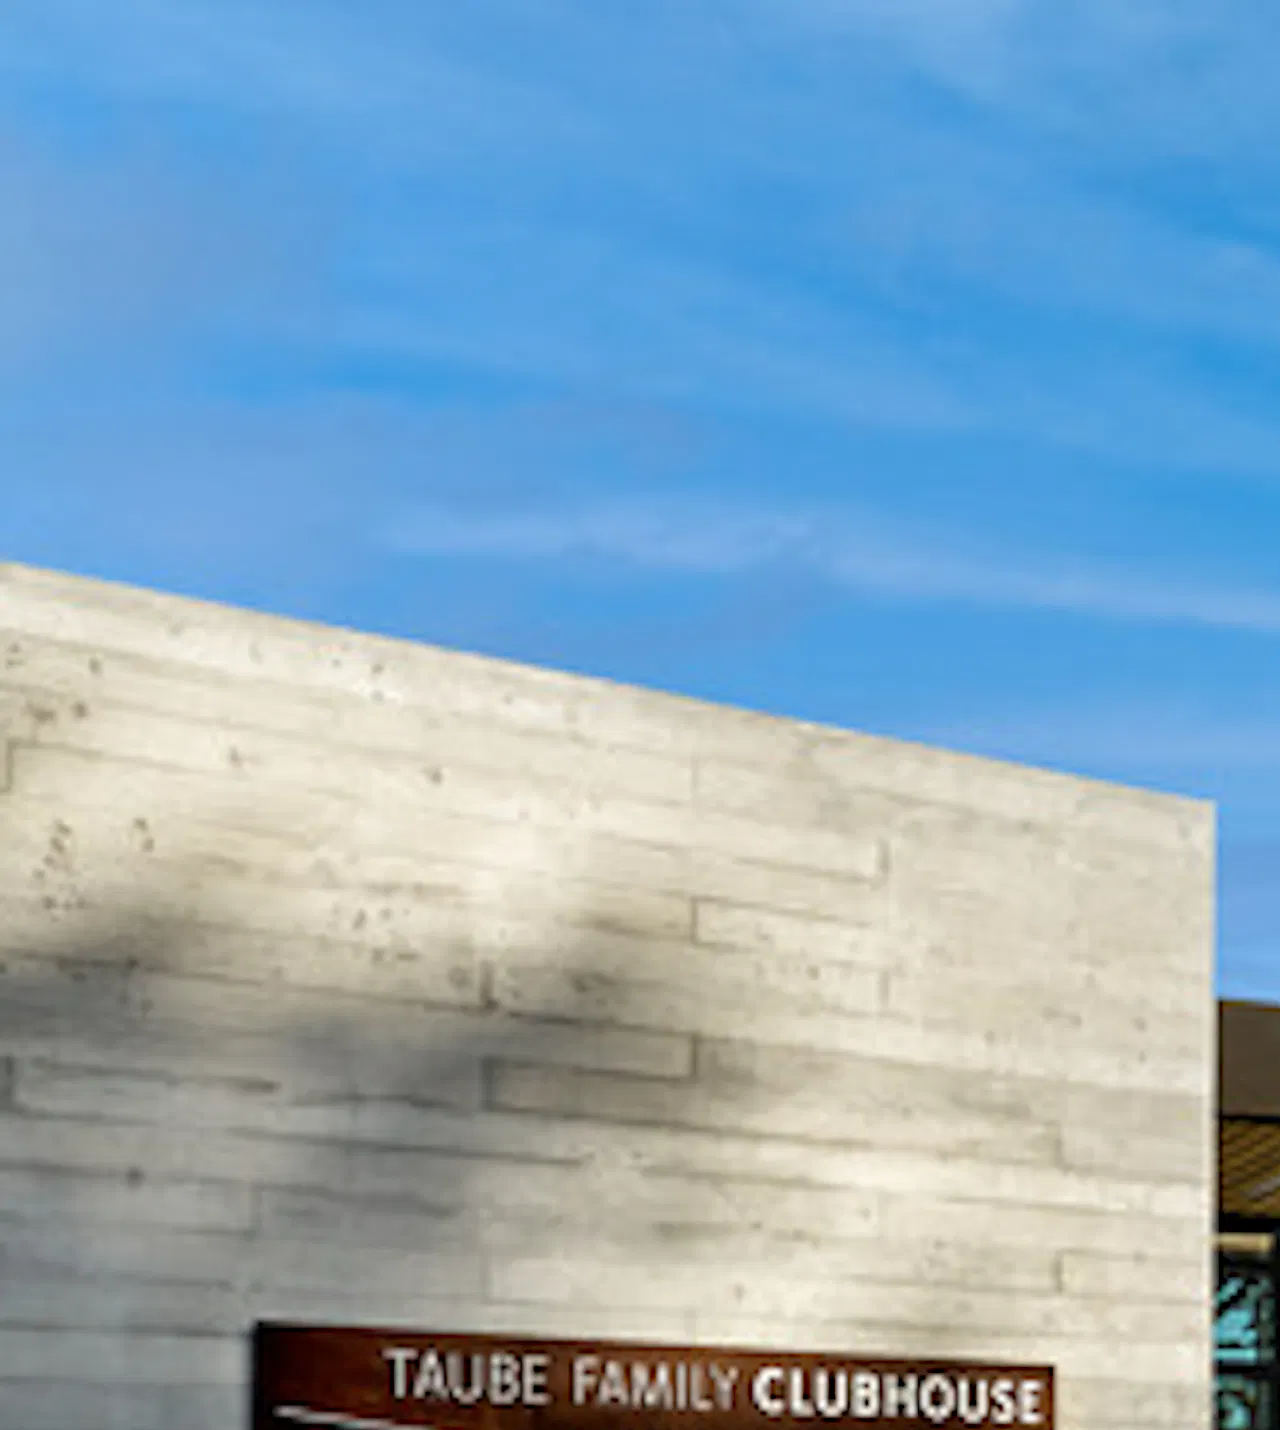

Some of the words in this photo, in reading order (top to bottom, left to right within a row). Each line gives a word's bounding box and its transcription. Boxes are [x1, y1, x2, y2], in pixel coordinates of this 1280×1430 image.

[383, 1347, 552, 1406] TAUBE
[572, 1355, 740, 1413] FAMILY
[752, 1366, 1046, 1427] CLUBHOUSE
